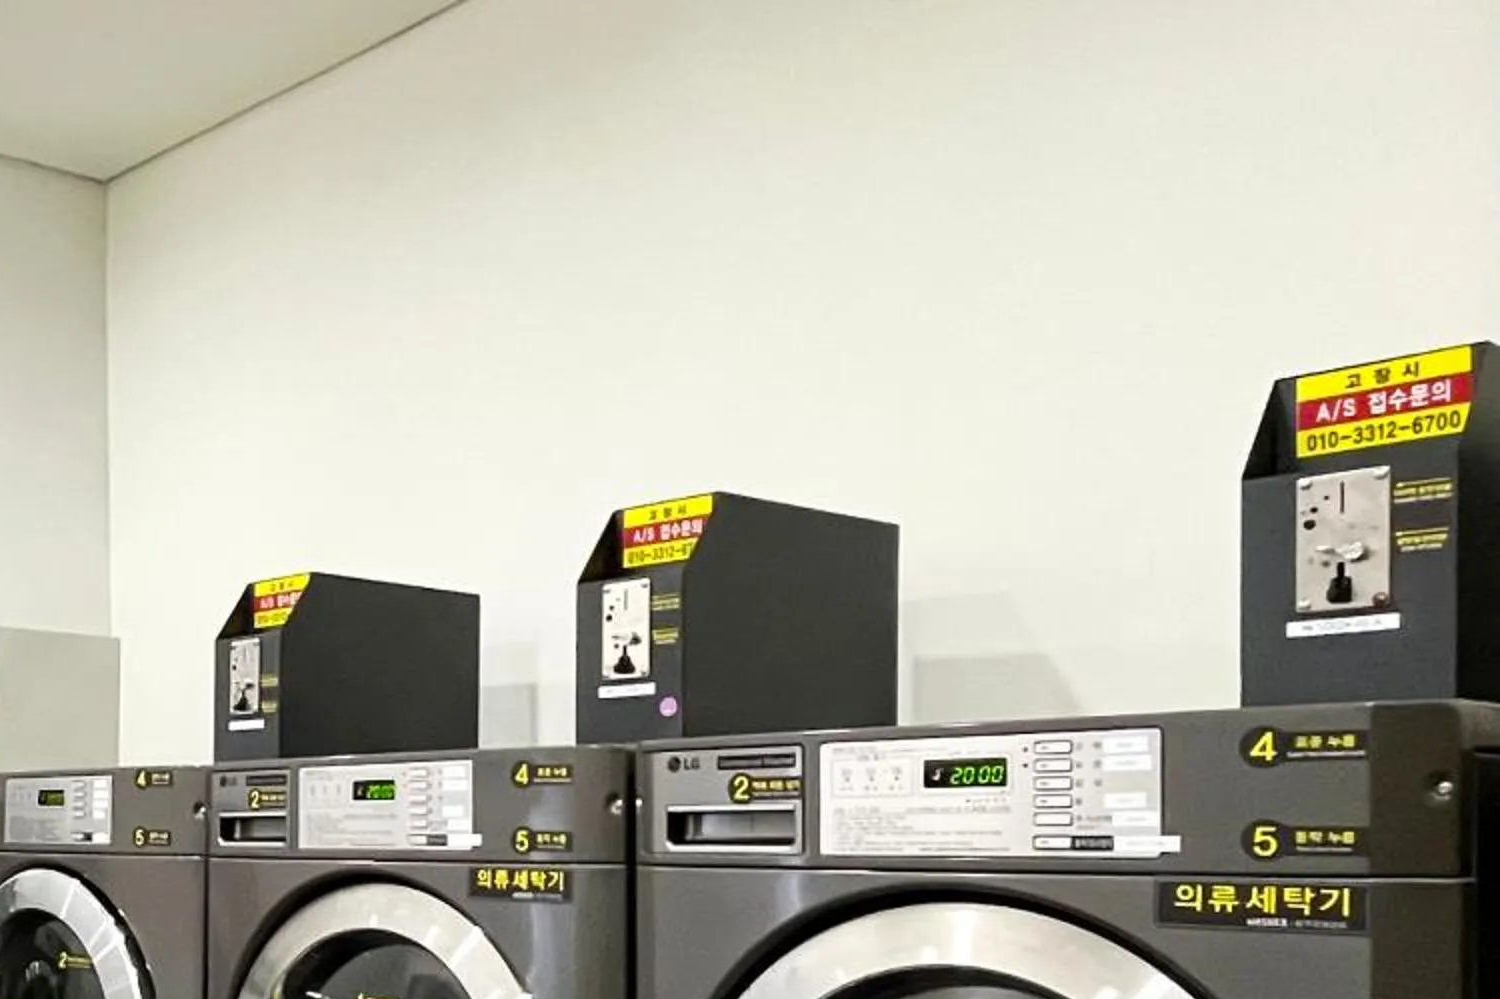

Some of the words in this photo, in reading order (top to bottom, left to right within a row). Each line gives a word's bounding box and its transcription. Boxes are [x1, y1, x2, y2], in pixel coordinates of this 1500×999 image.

[1315, 397, 1358, 423] A/S
[1367, 378, 1452, 415] 접수문의
[1306, 409, 1461, 451] 010-3312-6700
[1249, 730, 1279, 761] 4
[135, 771, 146, 787] 4
[514, 762, 529, 785] 4
[950, 765, 1005, 786] 2000
[733, 775, 750, 800] 2
[250, 791, 260, 809] 2
[514, 829, 530, 852] 5
[1252, 825, 1279, 857] 5
[476, 869, 565, 893] 의류세탁기
[1173, 884, 1350, 917] 의류세탁기
[57, 951, 68, 969] 2
